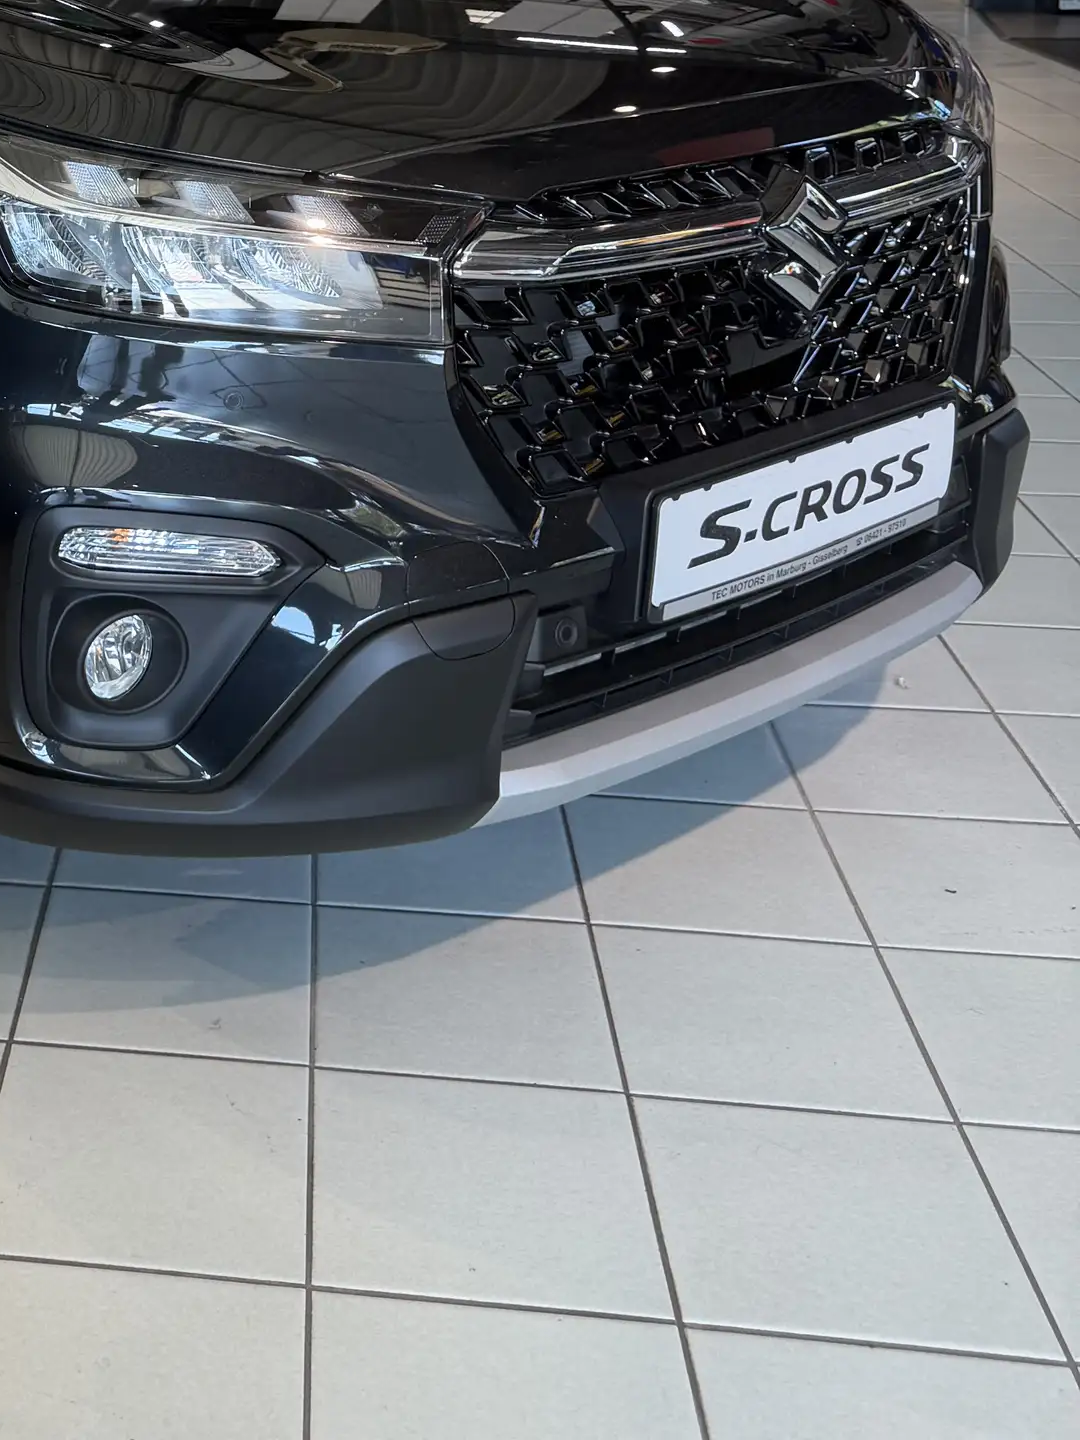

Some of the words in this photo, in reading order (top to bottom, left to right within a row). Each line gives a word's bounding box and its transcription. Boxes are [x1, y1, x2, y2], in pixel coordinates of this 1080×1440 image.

[687, 443, 930, 569] S-CROSS
[711, 587, 728, 602] TEC
[730, 575, 766, 596] MOTORS
[767, 570, 775, 584] in
[776, 560, 808, 580] Marburg
[812, 545, 849, 566] Gisselberg
